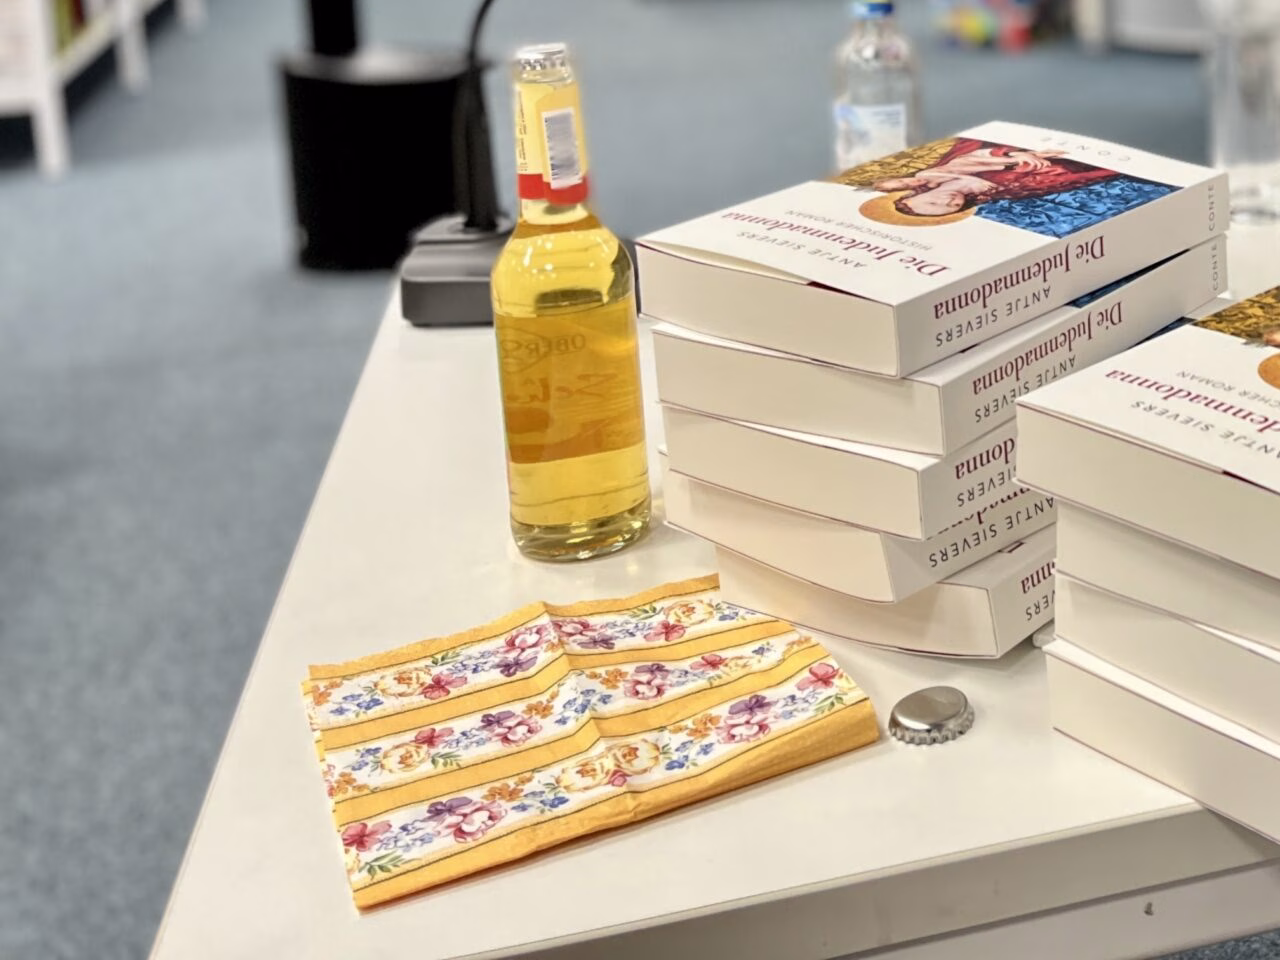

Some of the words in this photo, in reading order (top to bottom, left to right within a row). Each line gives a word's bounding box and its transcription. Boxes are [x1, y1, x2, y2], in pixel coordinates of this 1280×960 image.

[784, 209, 834, 226] ROMAN
[1208, 183, 1216, 232] CONTE
[722, 211, 904, 262] Judenmadonna
[736, 230, 807, 252] SIEVERS
[834, 218, 933, 252] HISTORISCHER
[1076, 235, 1105, 263] Die
[808, 247, 868, 269] ANTJE
[900, 256, 951, 277] Die
[933, 243, 1071, 320] Judenmadonna
[1005, 286, 1051, 317] ANTJE
[1096, 301, 1123, 330] Die
[935, 308, 997, 347] SIEVERS
[972, 311, 1092, 395] Judenmadonna
[1036, 354, 1077, 387] ANTJE
[1176, 370, 1237, 392] ROMAN
[975, 380, 1030, 423] SIEVERS
[1130, 399, 1214, 432] SIEVERS
[1006, 497, 1054, 530] ANTJE
[928, 523, 998, 568] SIEVERS
